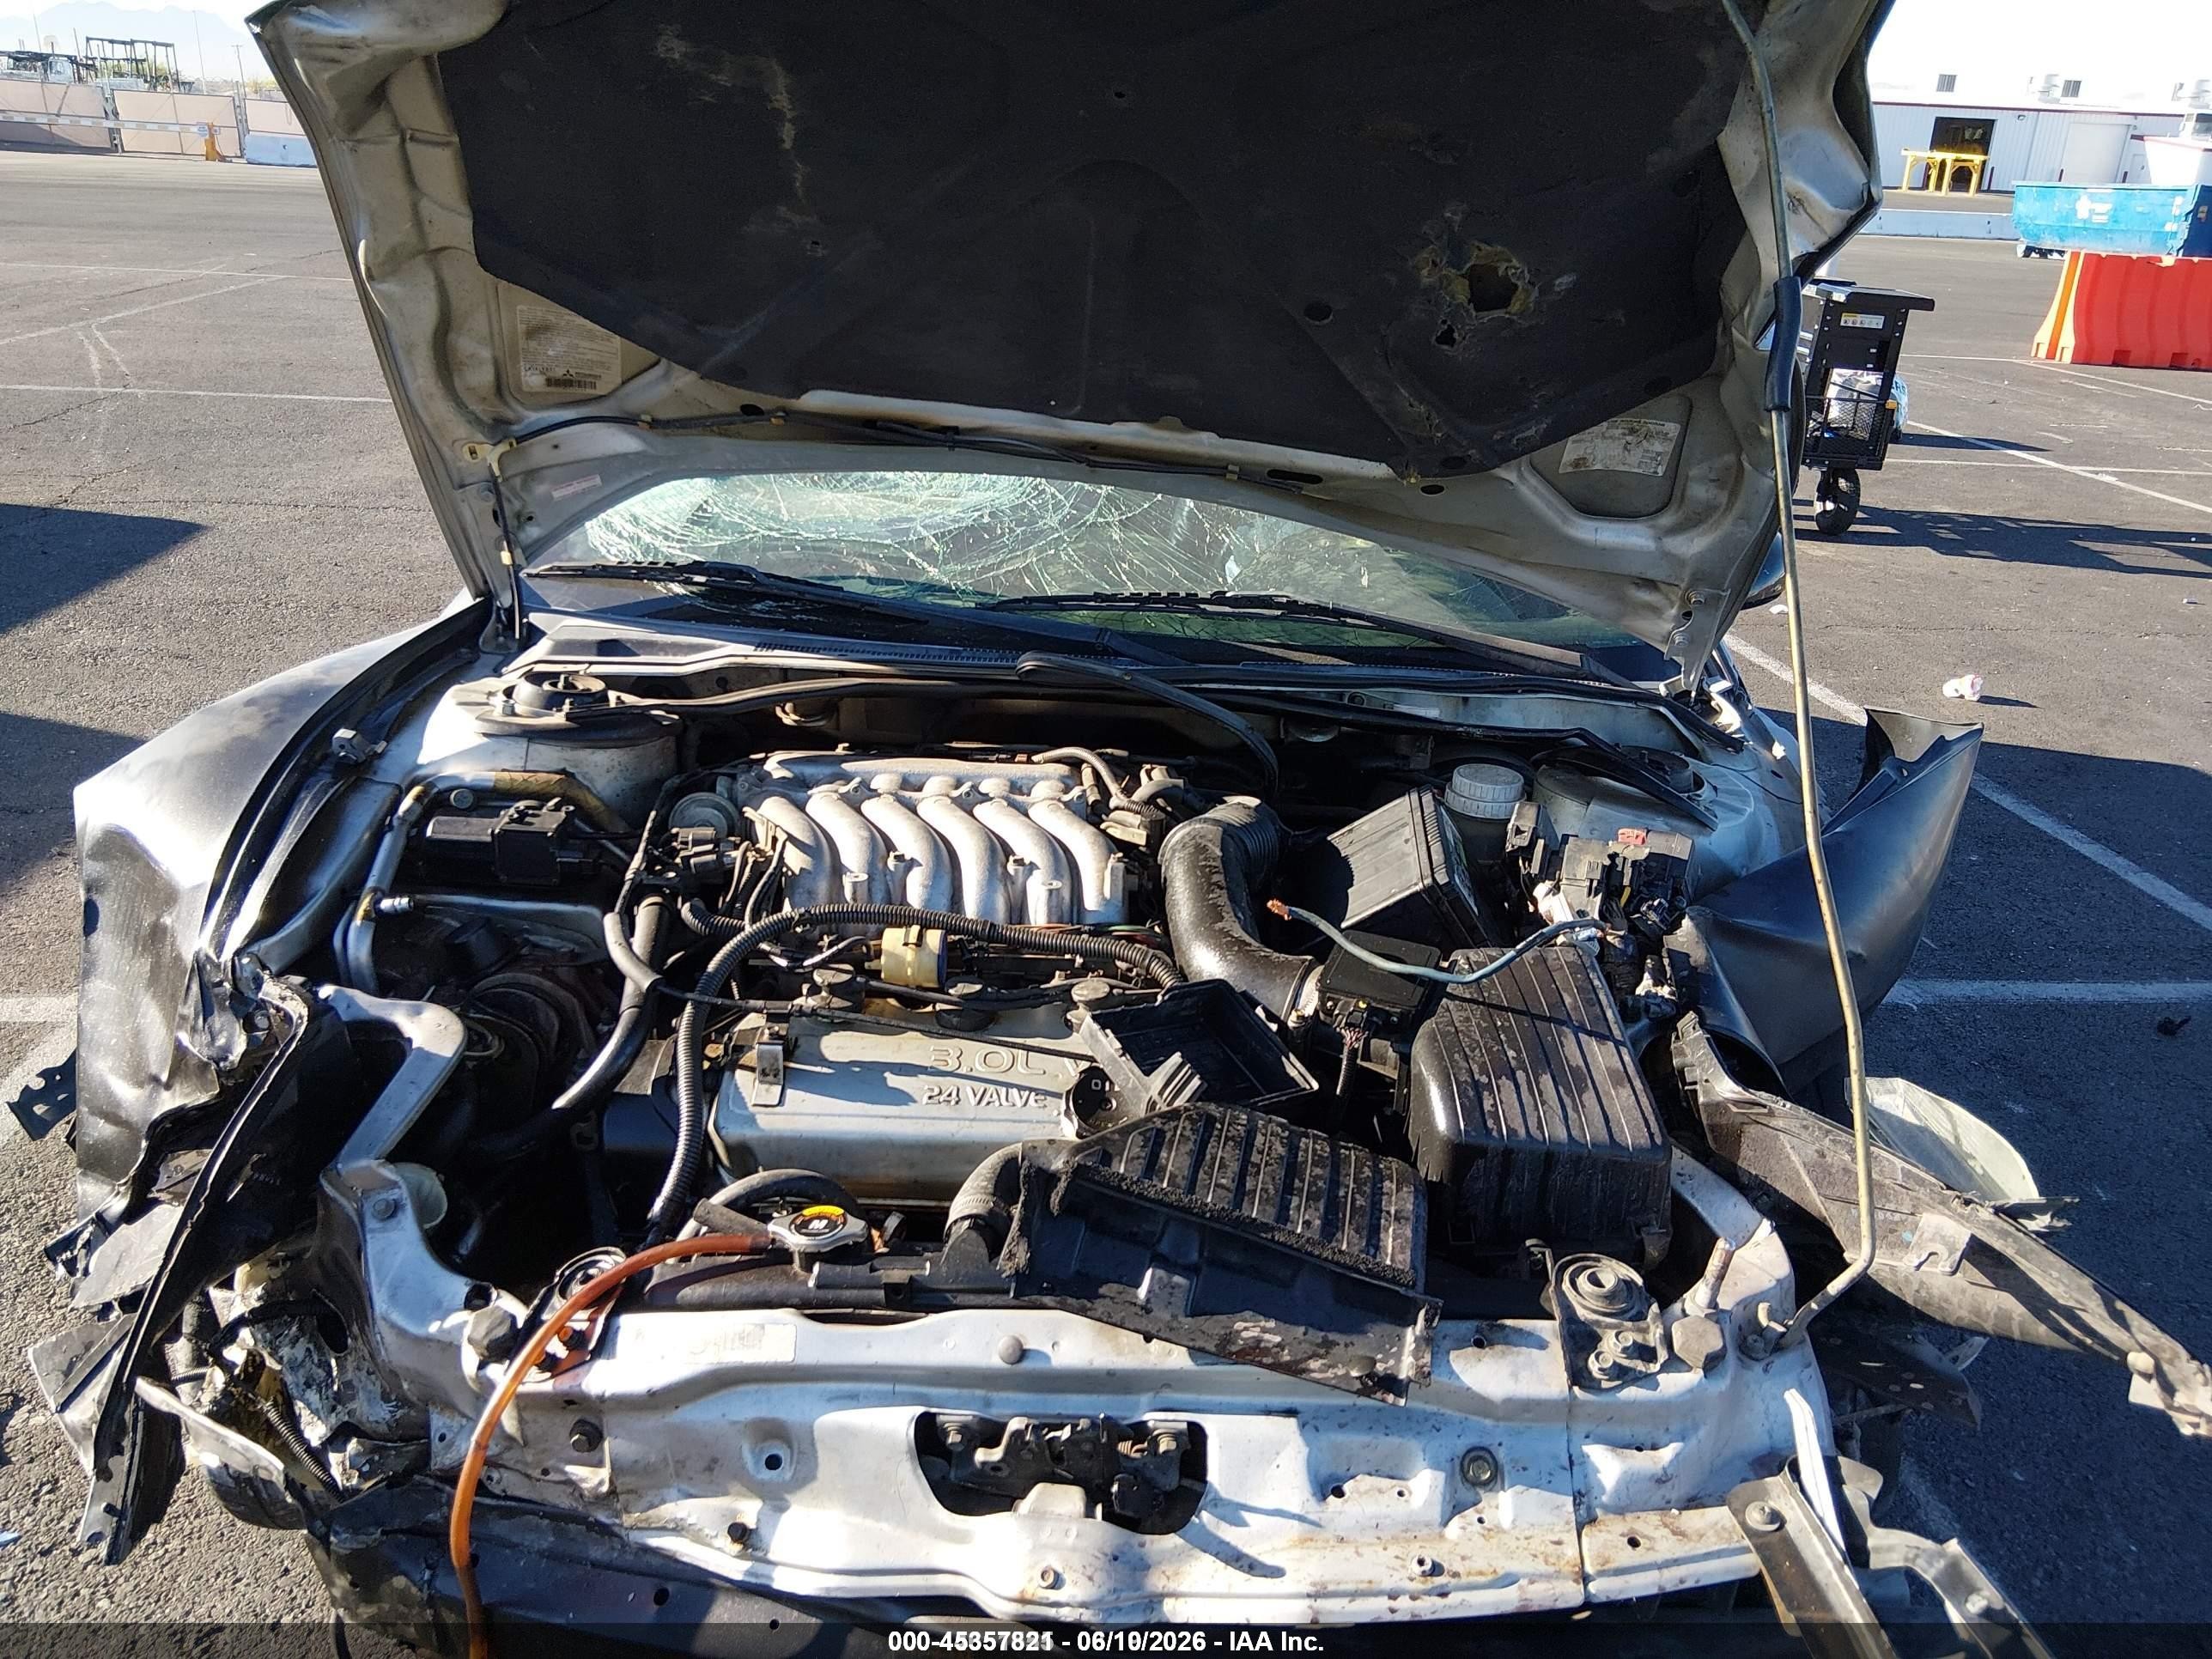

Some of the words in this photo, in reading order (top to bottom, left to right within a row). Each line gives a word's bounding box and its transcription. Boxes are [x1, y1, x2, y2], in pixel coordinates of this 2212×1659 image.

[930, 1045, 1046, 1075] 3.0L
[922, 1085, 961, 1106] 24
[965, 1085, 1048, 1109] VALVE
